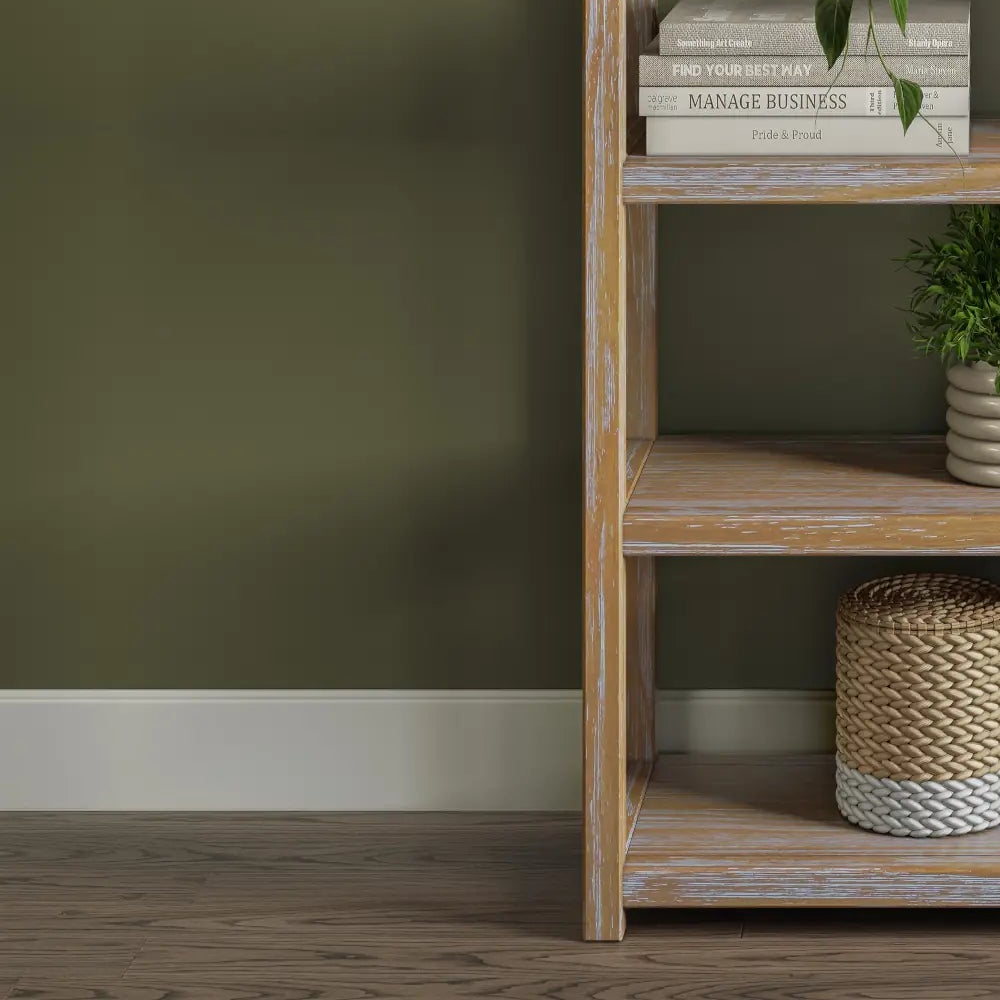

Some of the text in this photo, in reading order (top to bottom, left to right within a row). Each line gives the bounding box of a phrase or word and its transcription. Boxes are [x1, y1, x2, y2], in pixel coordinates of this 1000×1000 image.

[677, 39, 715, 48] Something
[716, 39, 728, 47] Art
[672, 64, 812, 77] FIND YOUR BEST WAY
[688, 93, 848, 109] MANAGE BUSINESS
[752, 129, 822, 140] Pride & Proud
